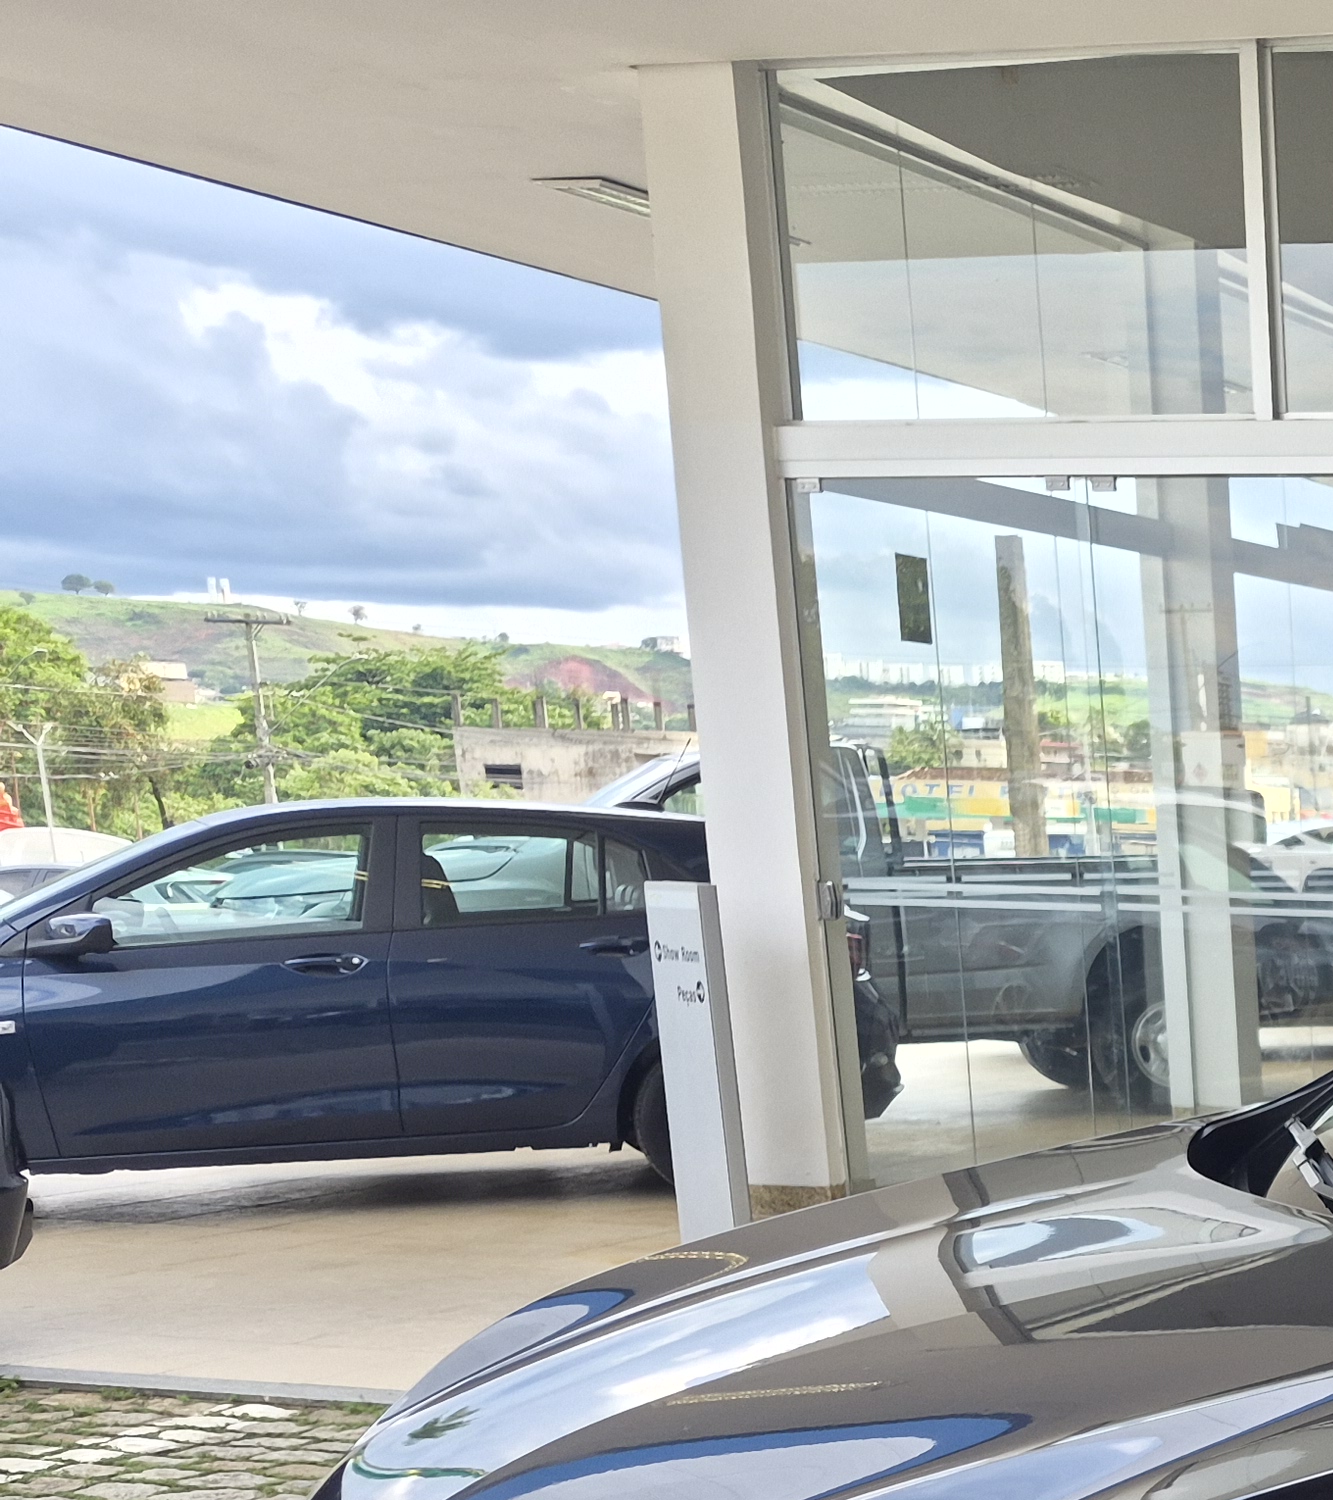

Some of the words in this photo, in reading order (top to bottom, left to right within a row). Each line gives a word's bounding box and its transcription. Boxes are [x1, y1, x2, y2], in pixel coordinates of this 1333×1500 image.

[662, 944, 679, 960] Show
[681, 946, 700, 963] Room
[677, 985, 697, 1007] Peças
